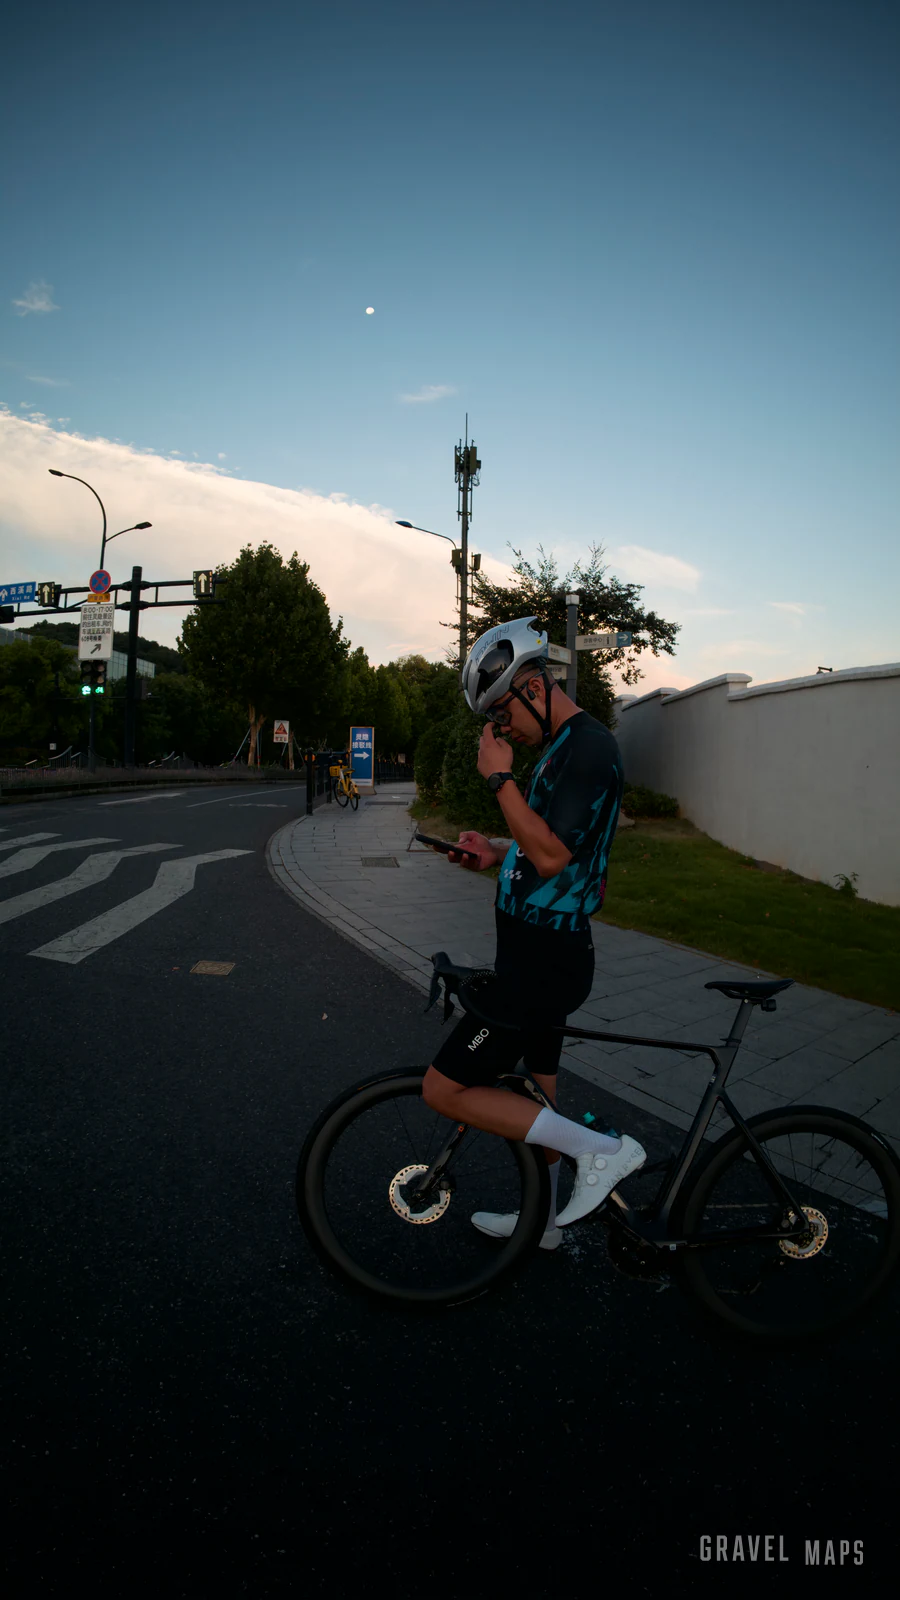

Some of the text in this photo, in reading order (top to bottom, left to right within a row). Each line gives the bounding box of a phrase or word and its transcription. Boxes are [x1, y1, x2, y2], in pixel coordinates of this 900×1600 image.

[10, 584, 33, 595] 西溪路
[467, 1028, 490, 1052] MBO
